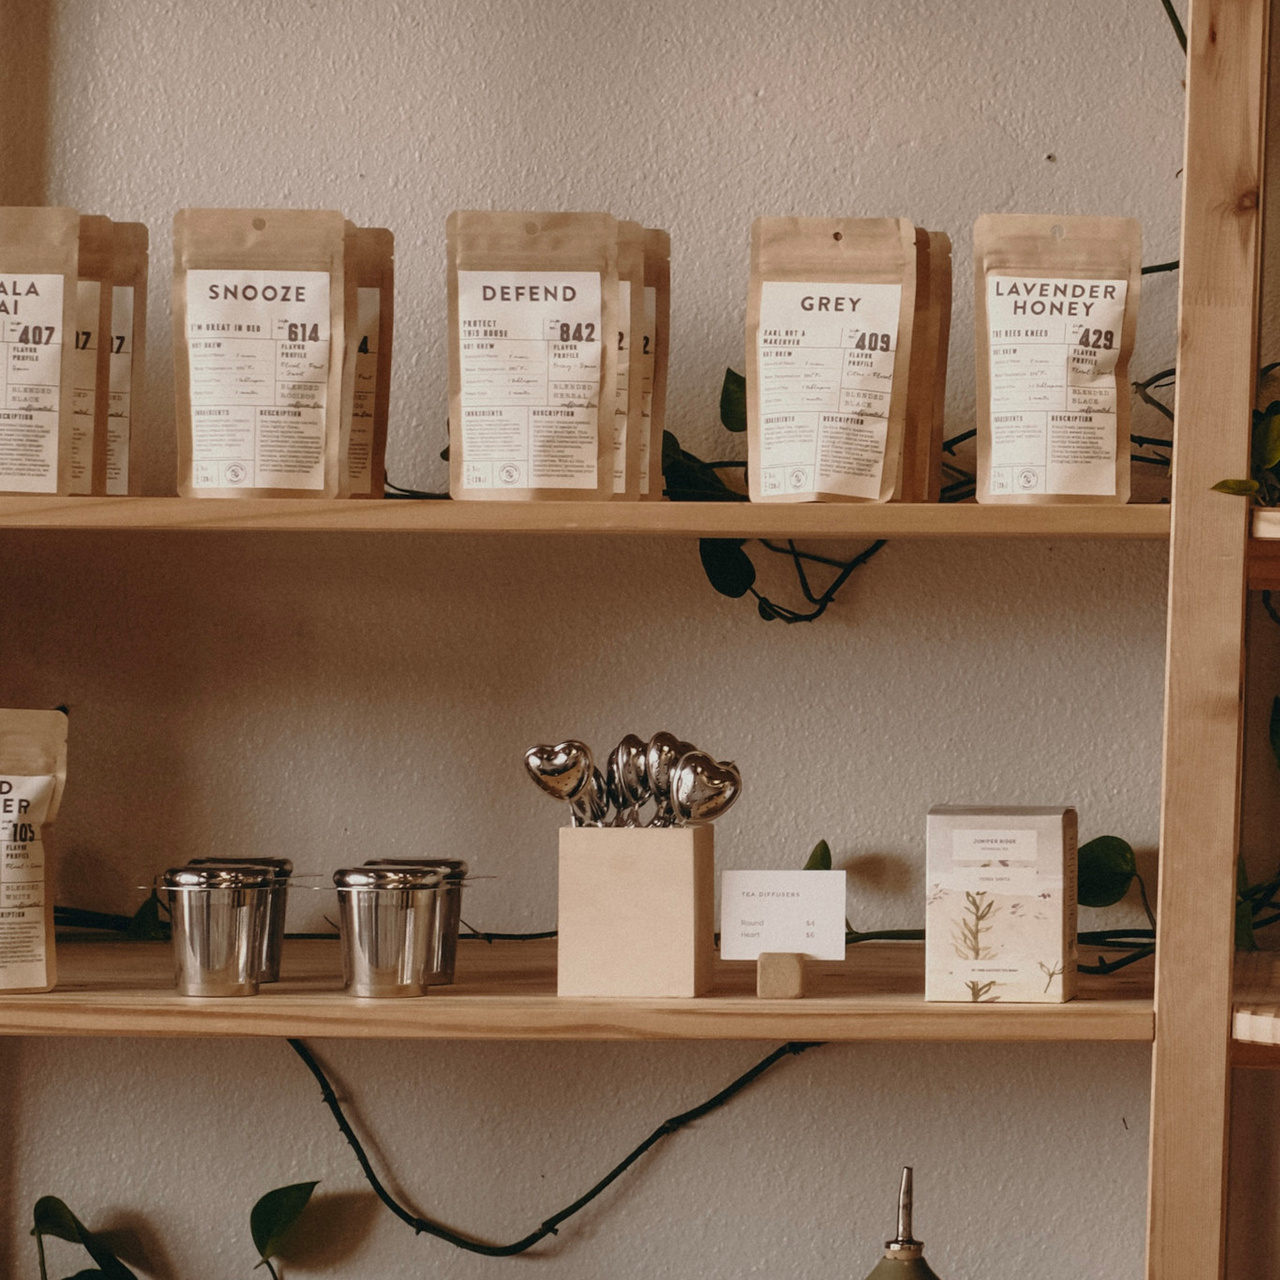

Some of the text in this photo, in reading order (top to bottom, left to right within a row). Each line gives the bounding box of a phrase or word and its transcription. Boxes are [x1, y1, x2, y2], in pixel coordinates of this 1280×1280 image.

[208, 284, 306, 301] SNOOZE
[482, 285, 577, 301] DEFEND
[996, 281, 1116, 299] LAVENDER
[800, 296, 862, 312] GREY
[1013, 300, 1094, 316] HONEY
[19, 325, 55, 345] 407
[288, 323, 320, 342] 614
[560, 322, 595, 342] 842
[1079, 328, 1114, 350] 429
[855, 332, 890, 352] 409
[823, 416, 864, 425] DESCRIPTION
[3, 798, 30, 815] ER
